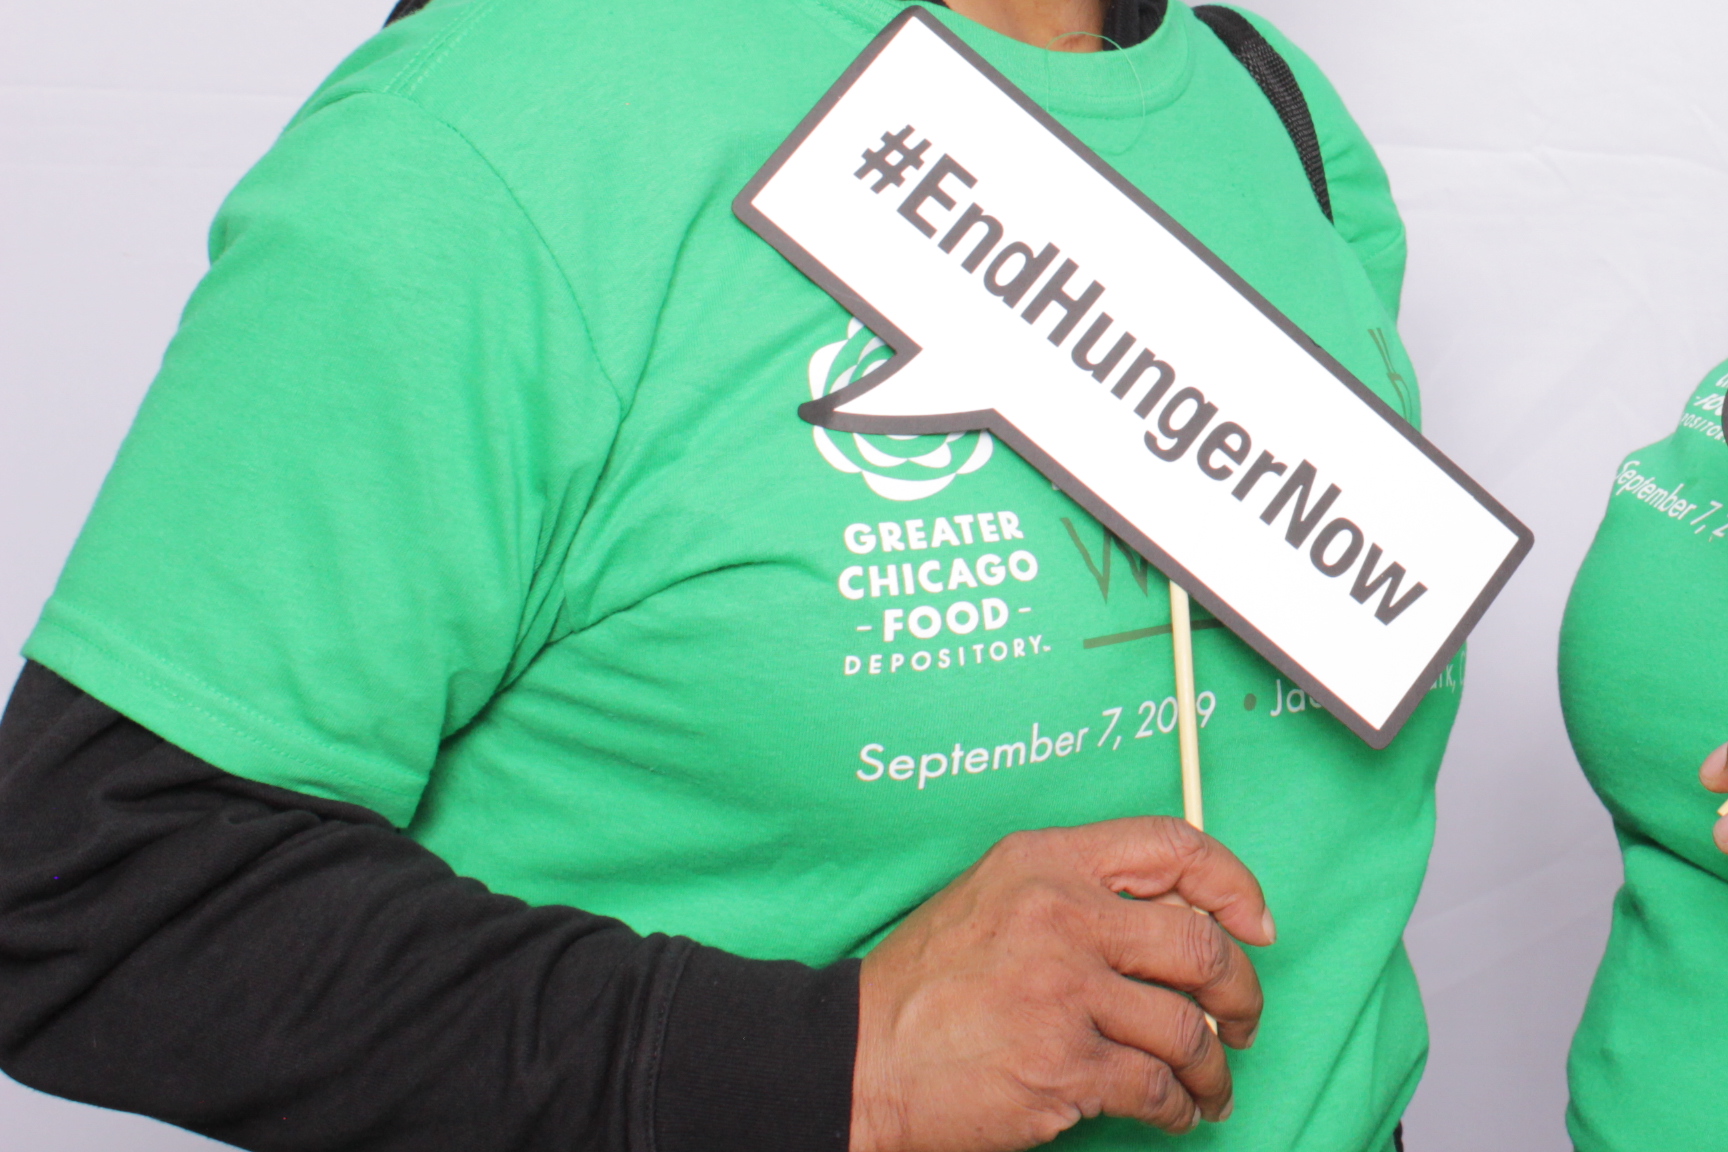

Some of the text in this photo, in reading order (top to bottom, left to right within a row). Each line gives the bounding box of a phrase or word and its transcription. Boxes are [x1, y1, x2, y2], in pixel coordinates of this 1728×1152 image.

[853, 124, 1428, 627] #EndHungerNow
[1615, 459, 1698, 521] September
[1690, 499, 1724, 535] 7,
[842, 510, 1025, 556] GREATER
[837, 549, 1039, 601] CHICAGO
[842, 634, 1045, 677] DEPOSITORY
[855, 722, 1090, 791] September
[1096, 706, 1124, 751] 7,
[1134, 690, 1217, 739] 209
